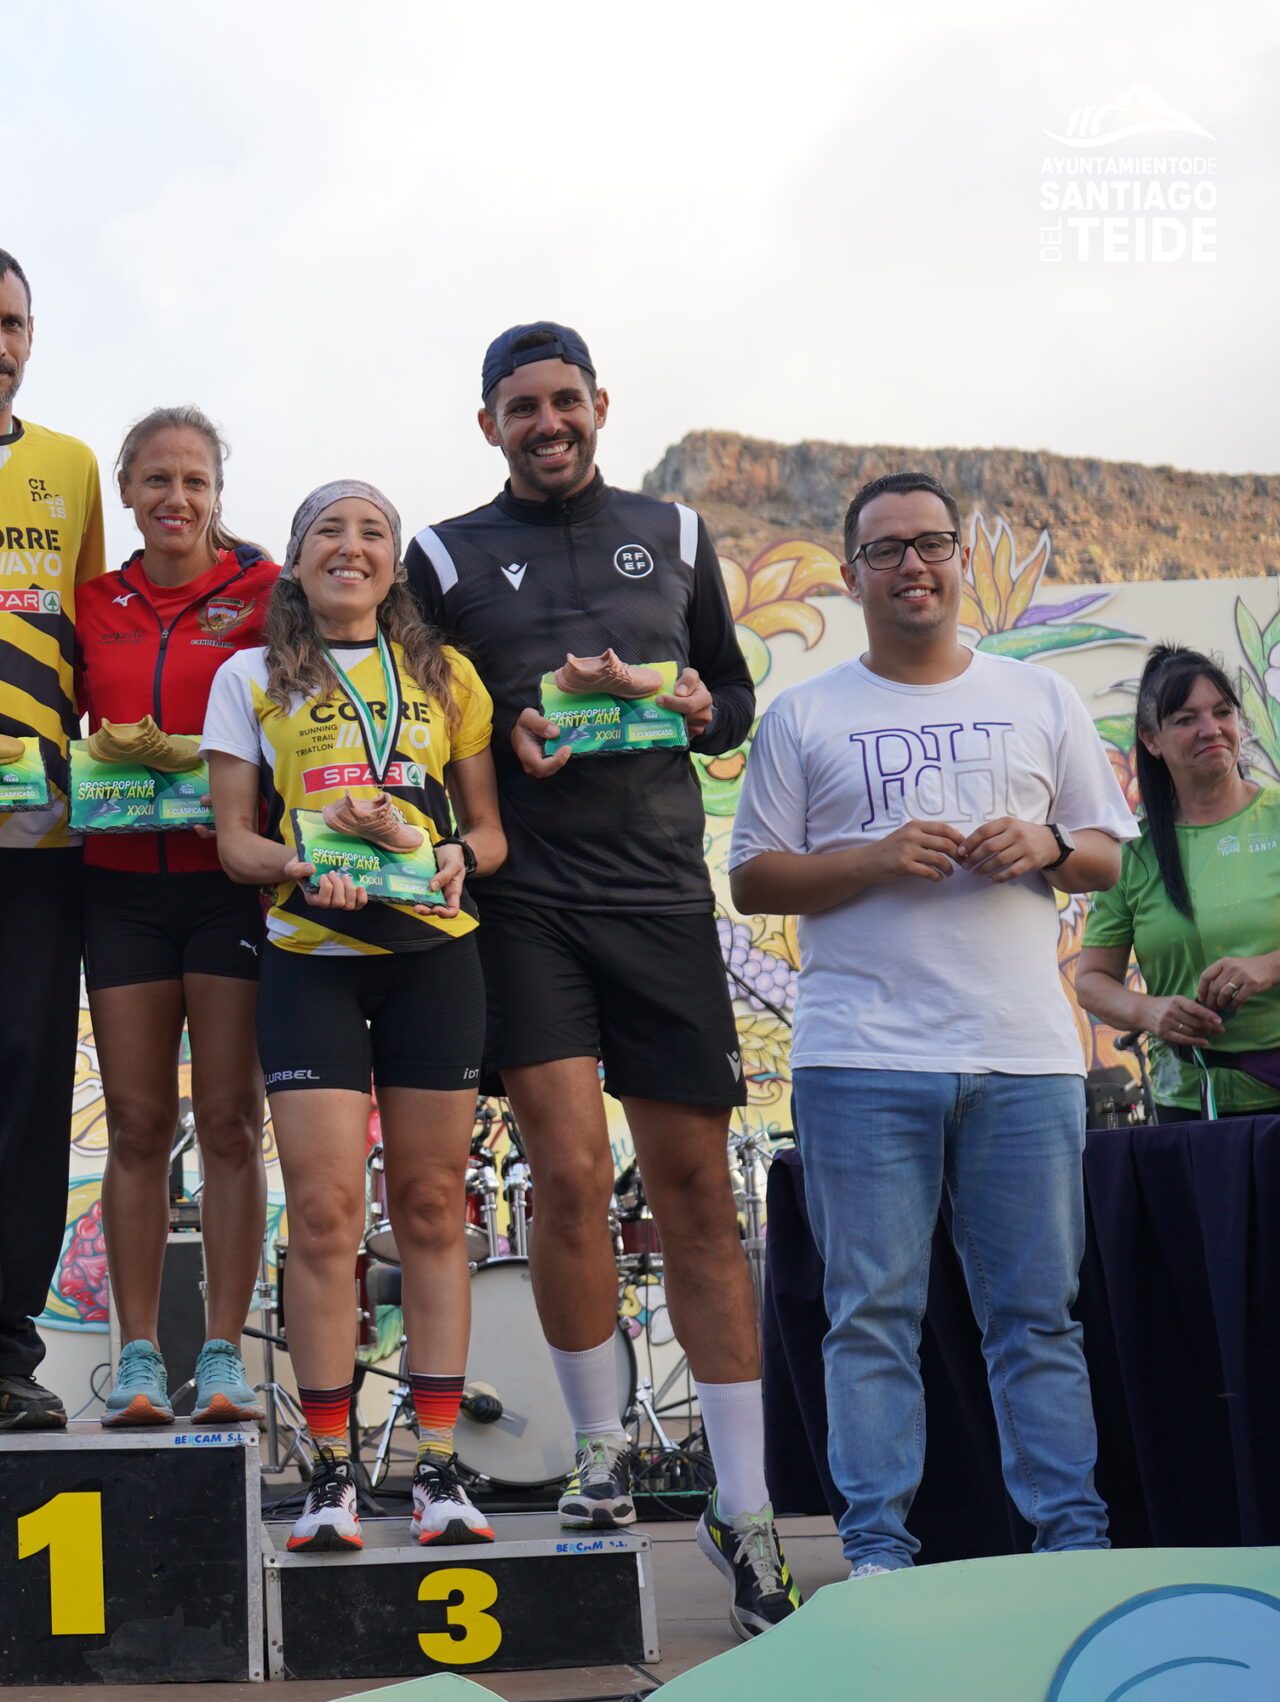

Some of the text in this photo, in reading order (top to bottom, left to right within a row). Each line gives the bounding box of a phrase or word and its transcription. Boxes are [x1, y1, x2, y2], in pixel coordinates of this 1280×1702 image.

[310, 701, 431, 724] CORRE
[595, 711, 621, 725] ANA
[299, 724, 338, 737] RUNNING
[595, 730, 621, 741] XXXII
[311, 734, 336, 744] TRAIL
[295, 744, 334, 758] TRIATLON
[77, 785, 155, 800] SANTA ANA
[126, 804, 155, 815] XXXII
[1248, 840, 1278, 854] SANTA
[312, 852, 381, 872] SANTA ANA
[265, 1069, 320, 1086] LURBEL
[17, 1491, 106, 1635] 1
[417, 1568, 502, 1664] 3
